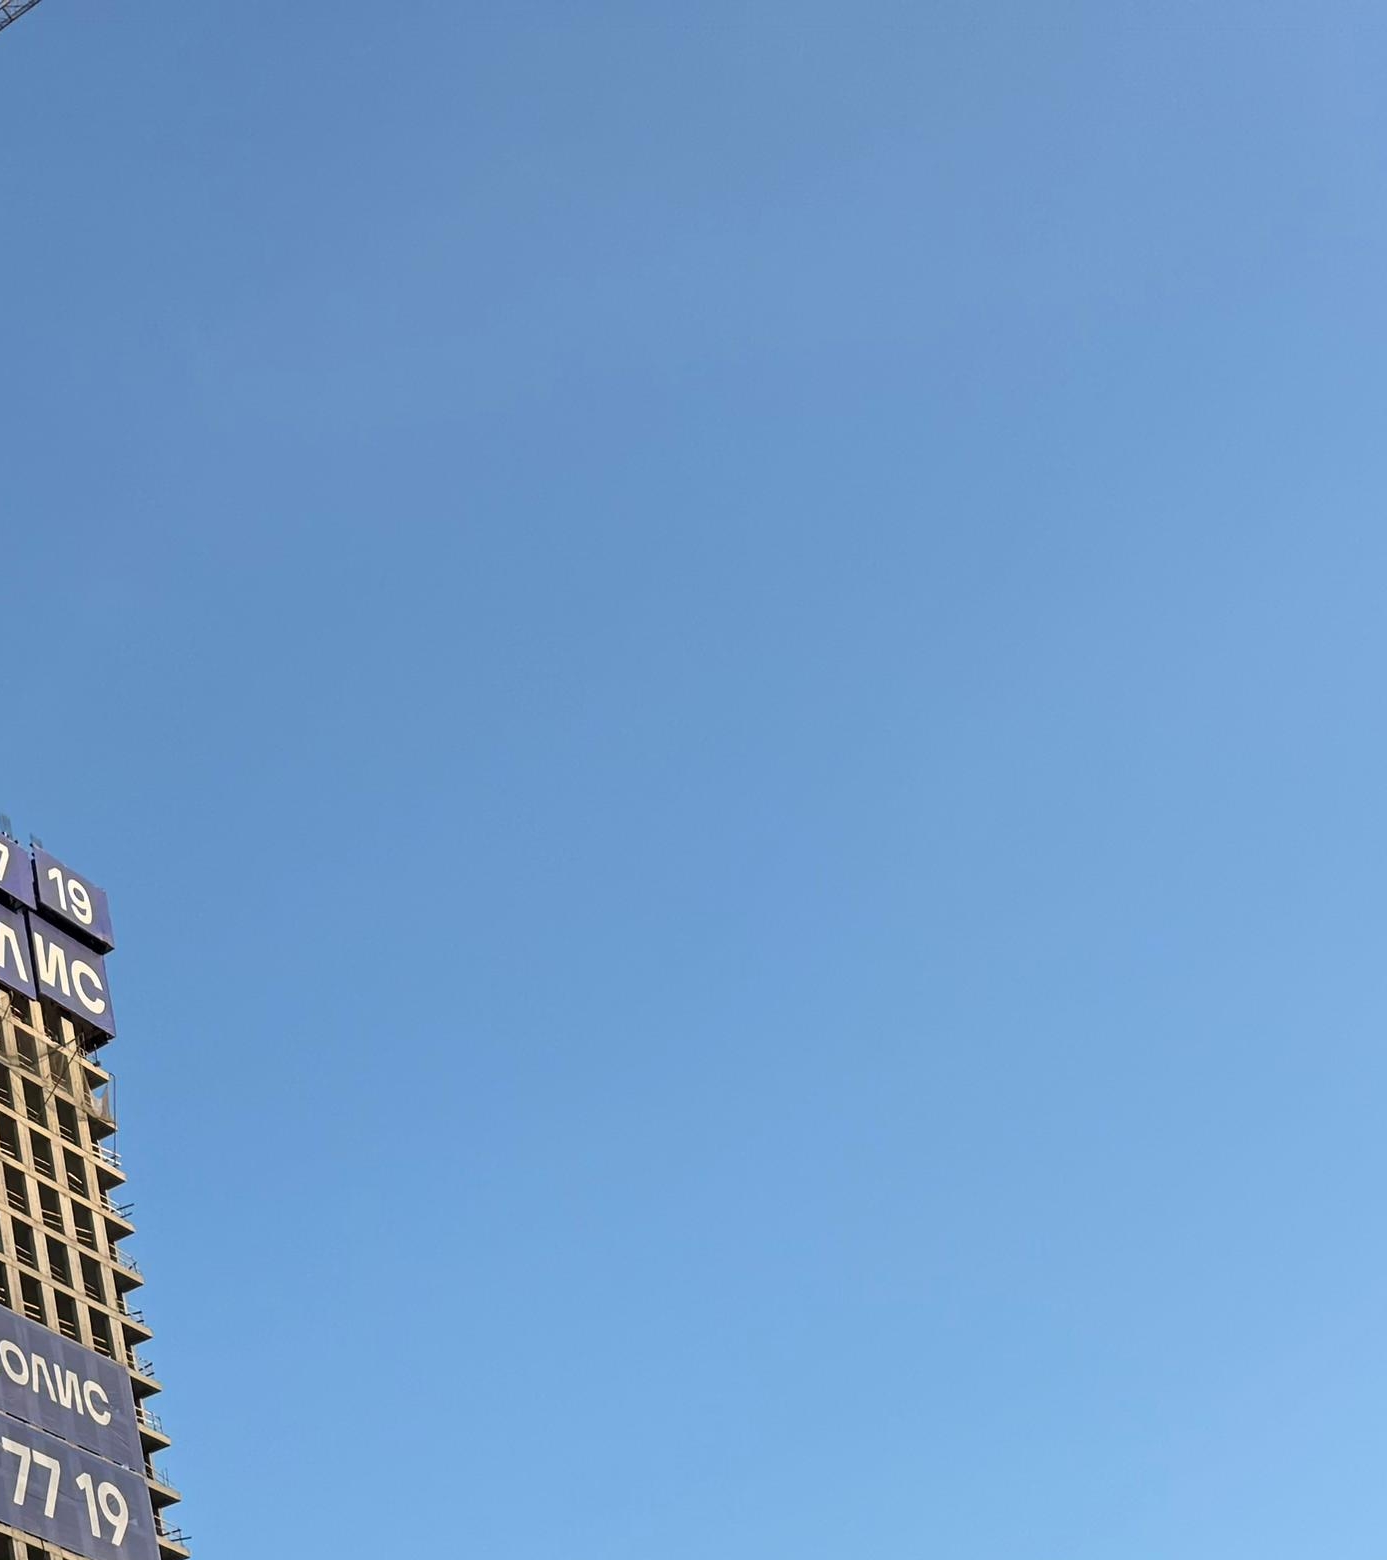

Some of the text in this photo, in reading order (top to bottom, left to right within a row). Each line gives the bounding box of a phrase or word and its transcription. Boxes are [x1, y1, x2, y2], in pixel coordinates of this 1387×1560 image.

[48, 867, 93, 925] 19
[2, 1437, 60, 1518] 77
[76, 1473, 129, 1546] 19
